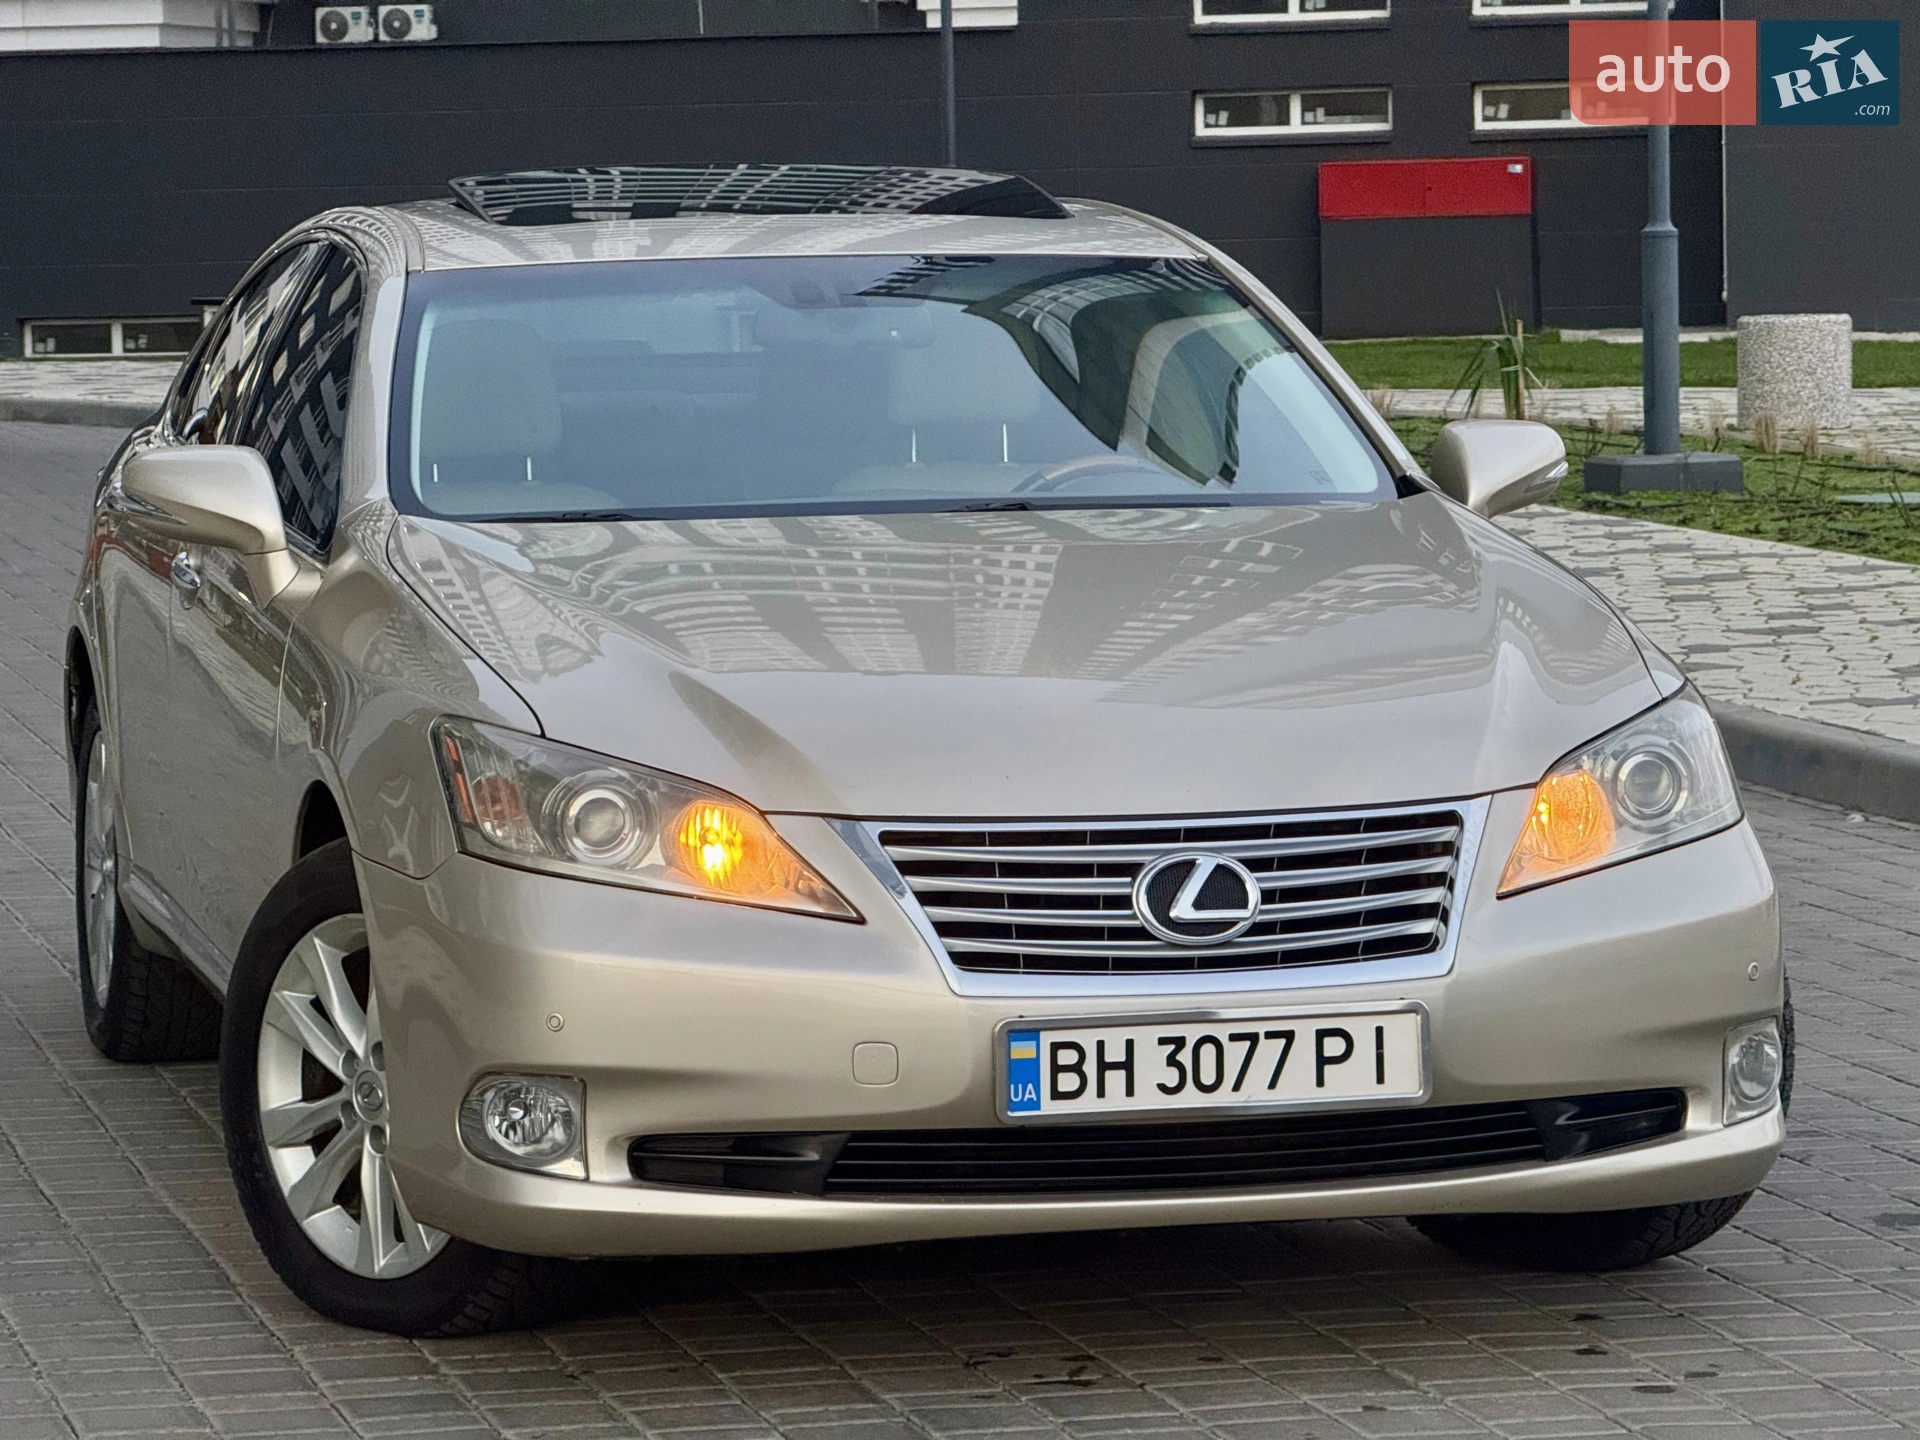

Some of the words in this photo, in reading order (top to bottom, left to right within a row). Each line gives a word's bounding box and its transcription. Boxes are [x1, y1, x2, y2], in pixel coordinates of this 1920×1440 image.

[1049, 1038, 1135, 1101] BH
[1156, 1029, 1296, 1096] 3077
[1010, 1083, 1037, 1102] UA
